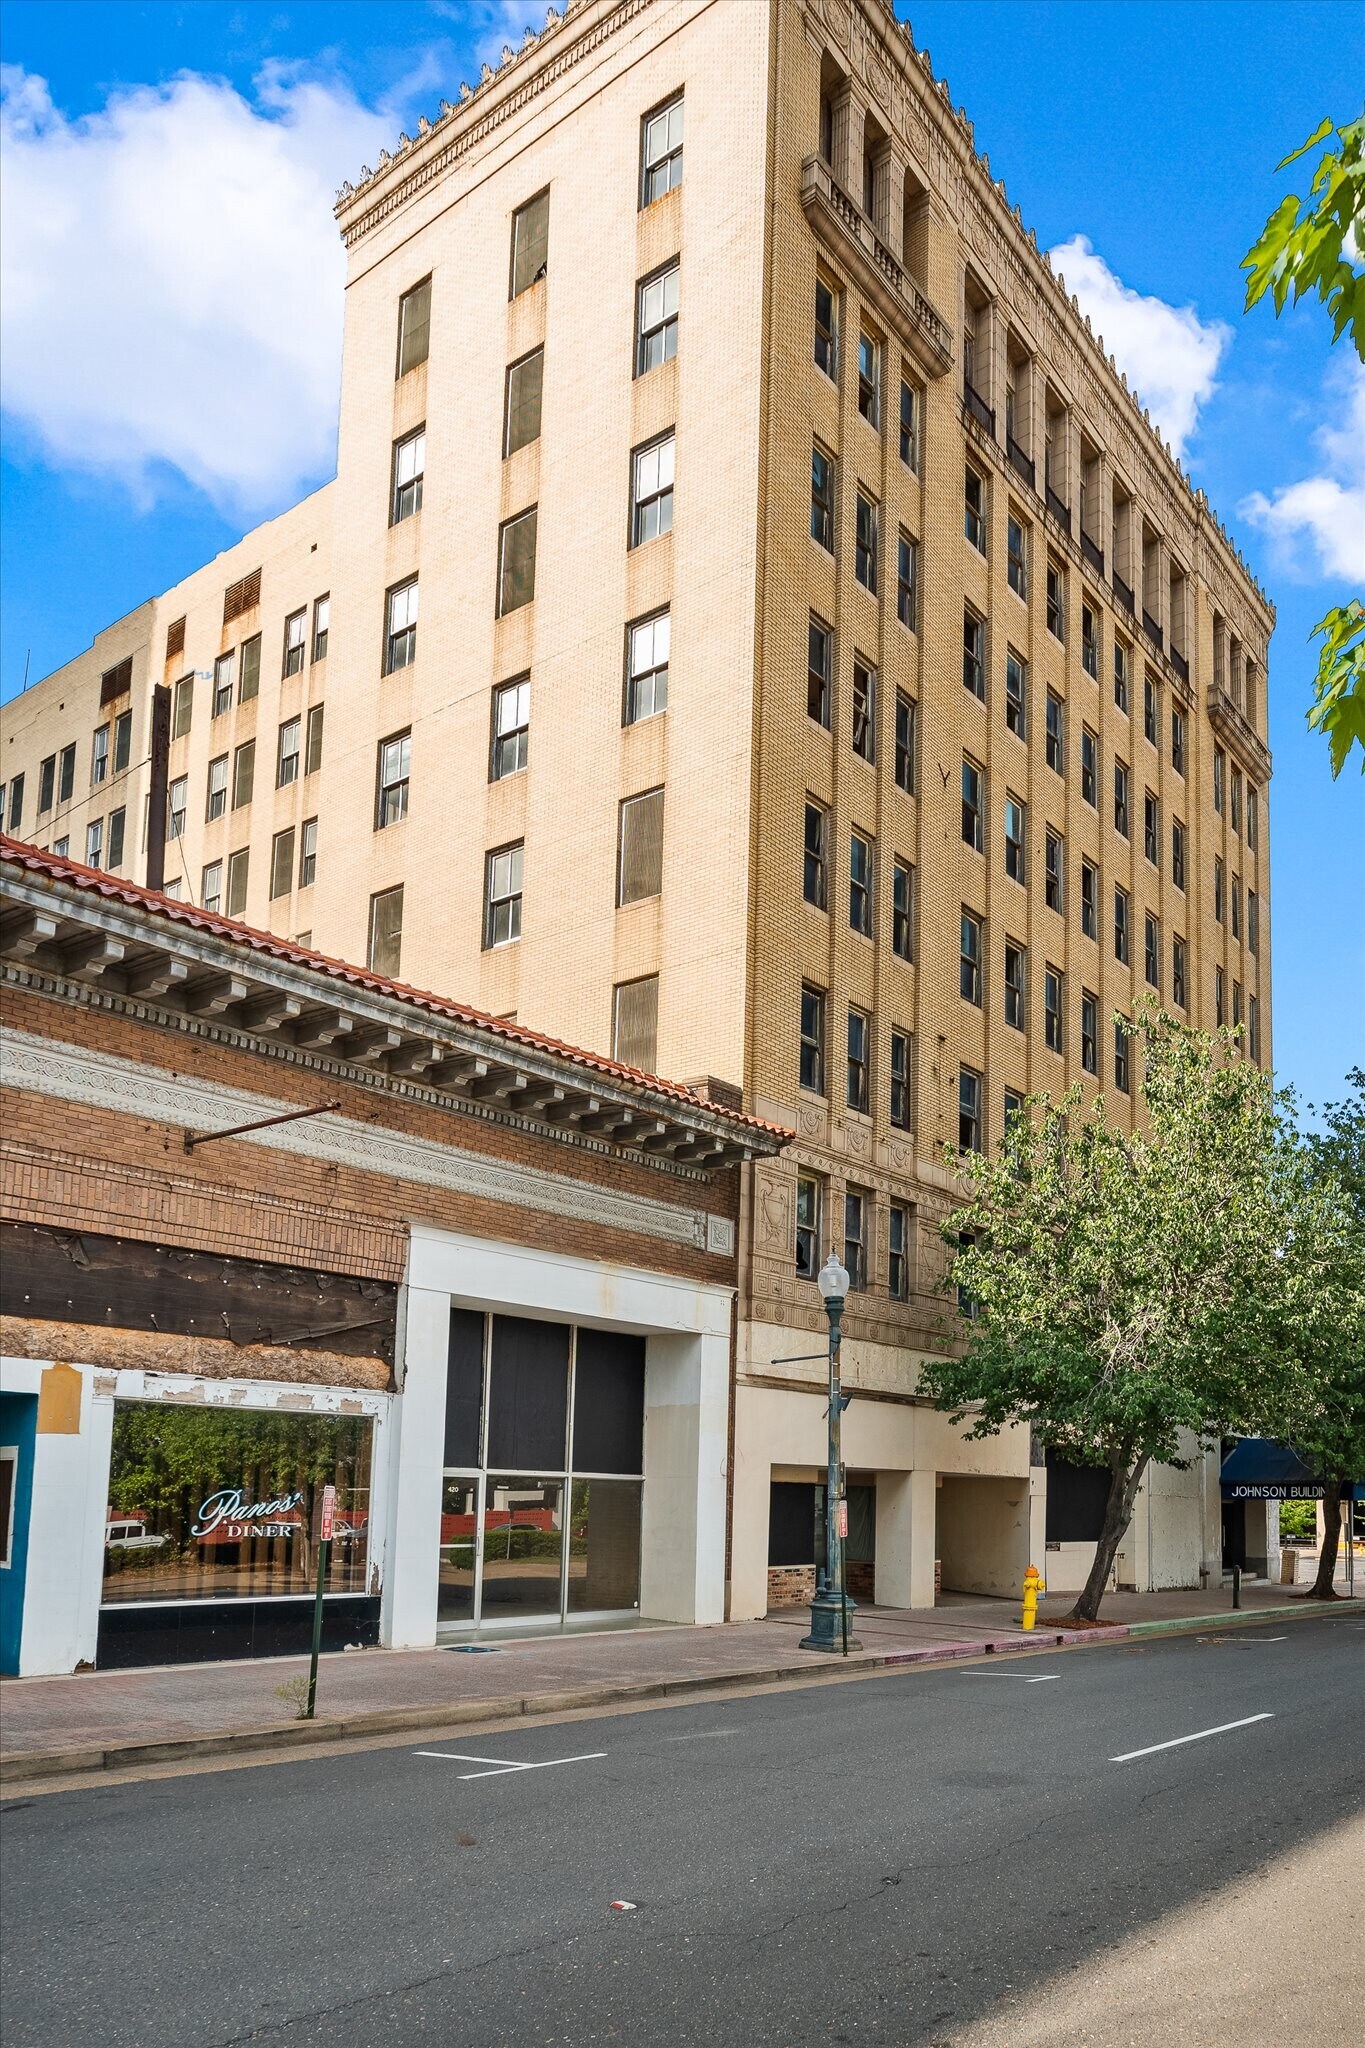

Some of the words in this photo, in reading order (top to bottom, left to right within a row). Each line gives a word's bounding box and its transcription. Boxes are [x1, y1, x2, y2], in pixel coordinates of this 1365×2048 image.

[1231, 1486, 1287, 1497] JOHNSON
[1290, 1486, 1326, 1497] BUILDIN
[191, 1489, 301, 1537] Panos'
[227, 1525, 291, 1537] DINER
